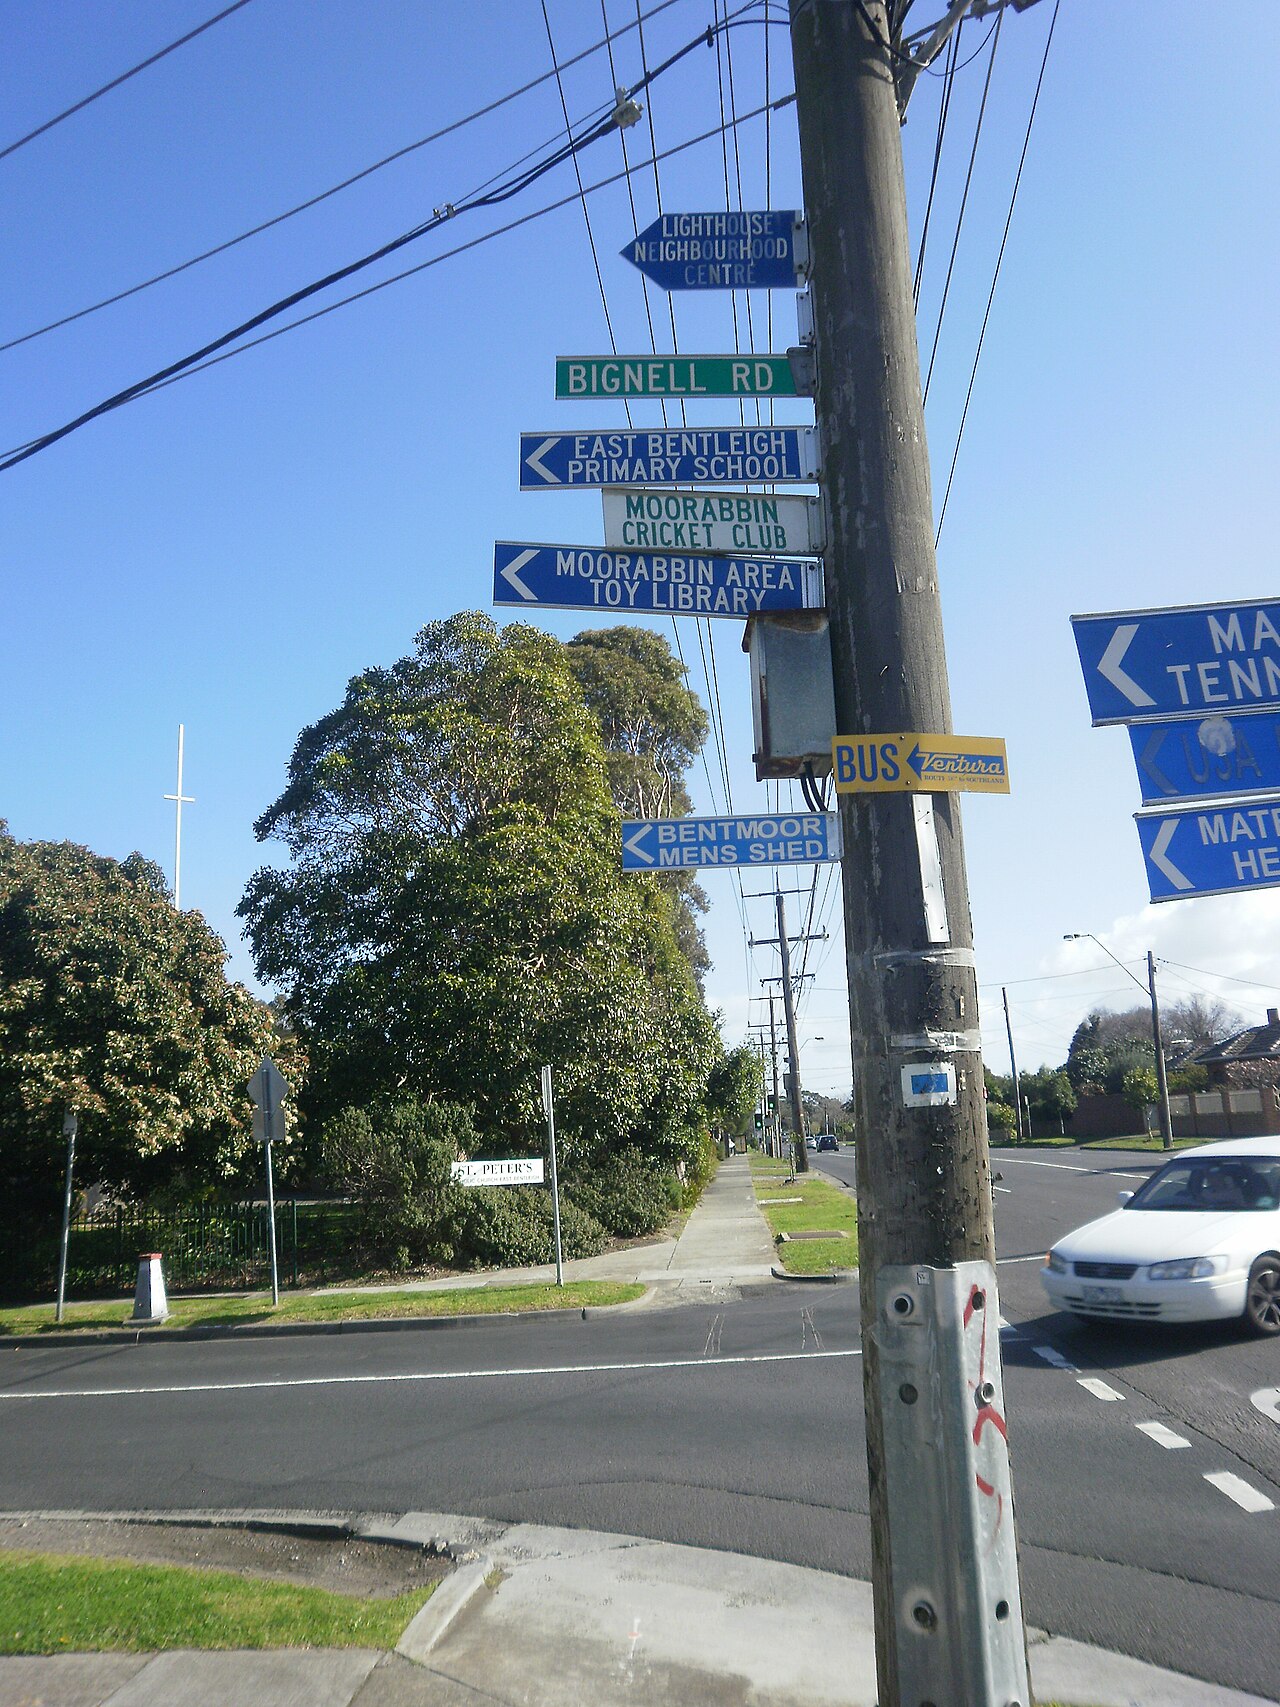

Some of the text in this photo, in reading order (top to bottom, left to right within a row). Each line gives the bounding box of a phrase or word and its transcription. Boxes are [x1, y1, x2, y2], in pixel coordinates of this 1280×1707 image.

[662, 213, 774, 238] LIGHTHOUSE
[634, 237, 788, 262] NEIGHBOURHOOD
[684, 263, 756, 285] CENTRE
[568, 362, 774, 394] BIGNELL RD
[574, 431, 787, 459] EAST BENTLEIGH
[568, 455, 797, 483] PRIMARY SCHOOL
[626, 495, 778, 524] MOORABBIN
[622, 520, 787, 549] CRICKET CLUB
[556, 551, 795, 591] MOORABBIN AREA
[590, 578, 767, 613] TOY LIBRARY
[836, 743, 900, 783] BUS
[915, 753, 1004, 775] Ventura
[924, 774, 945, 782] ROUTE
[966, 776, 1005, 785] SOUTHLAND
[658, 817, 824, 845] BENTMOOR
[659, 840, 824, 867] MENS SHED
[483, 1162, 533, 1175] PETER'S
